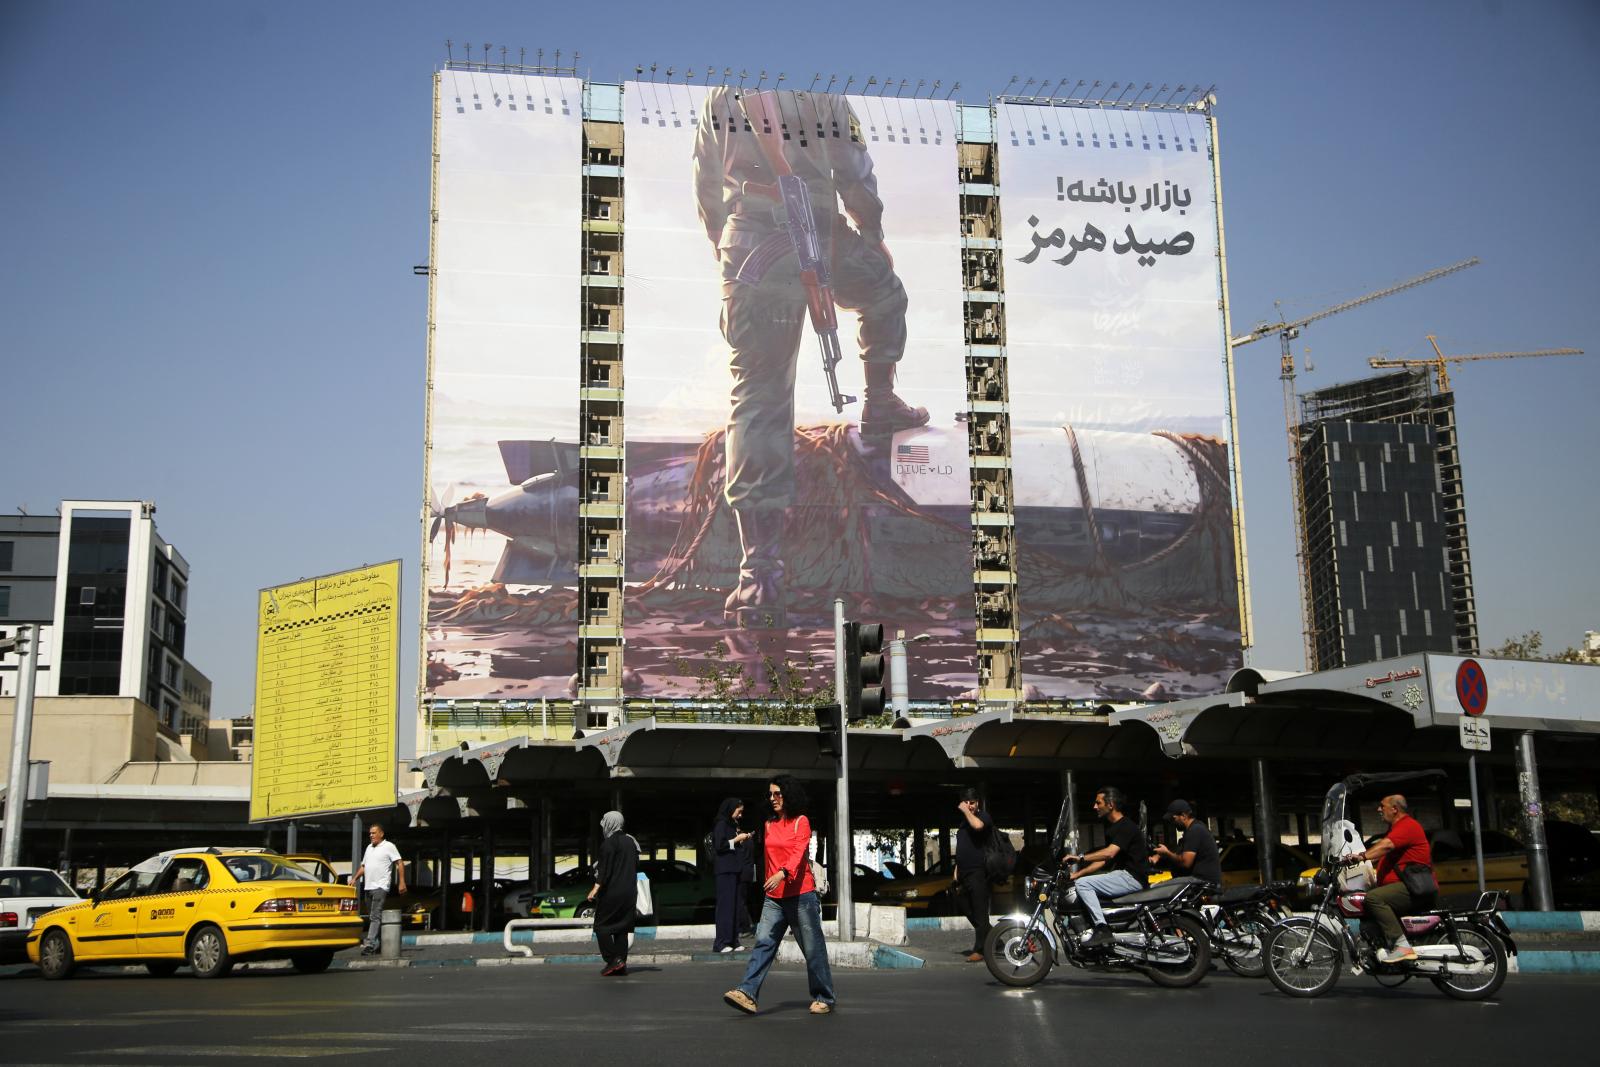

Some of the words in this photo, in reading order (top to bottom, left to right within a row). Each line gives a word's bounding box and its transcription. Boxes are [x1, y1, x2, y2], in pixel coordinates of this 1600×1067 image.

[1056, 175, 1137, 213] باشه!
[1140, 180, 1192, 216] بازار
[1016, 213, 1107, 267] هرمز
[1113, 223, 1195, 268] صید
[896, 464, 927, 475] DIVE
